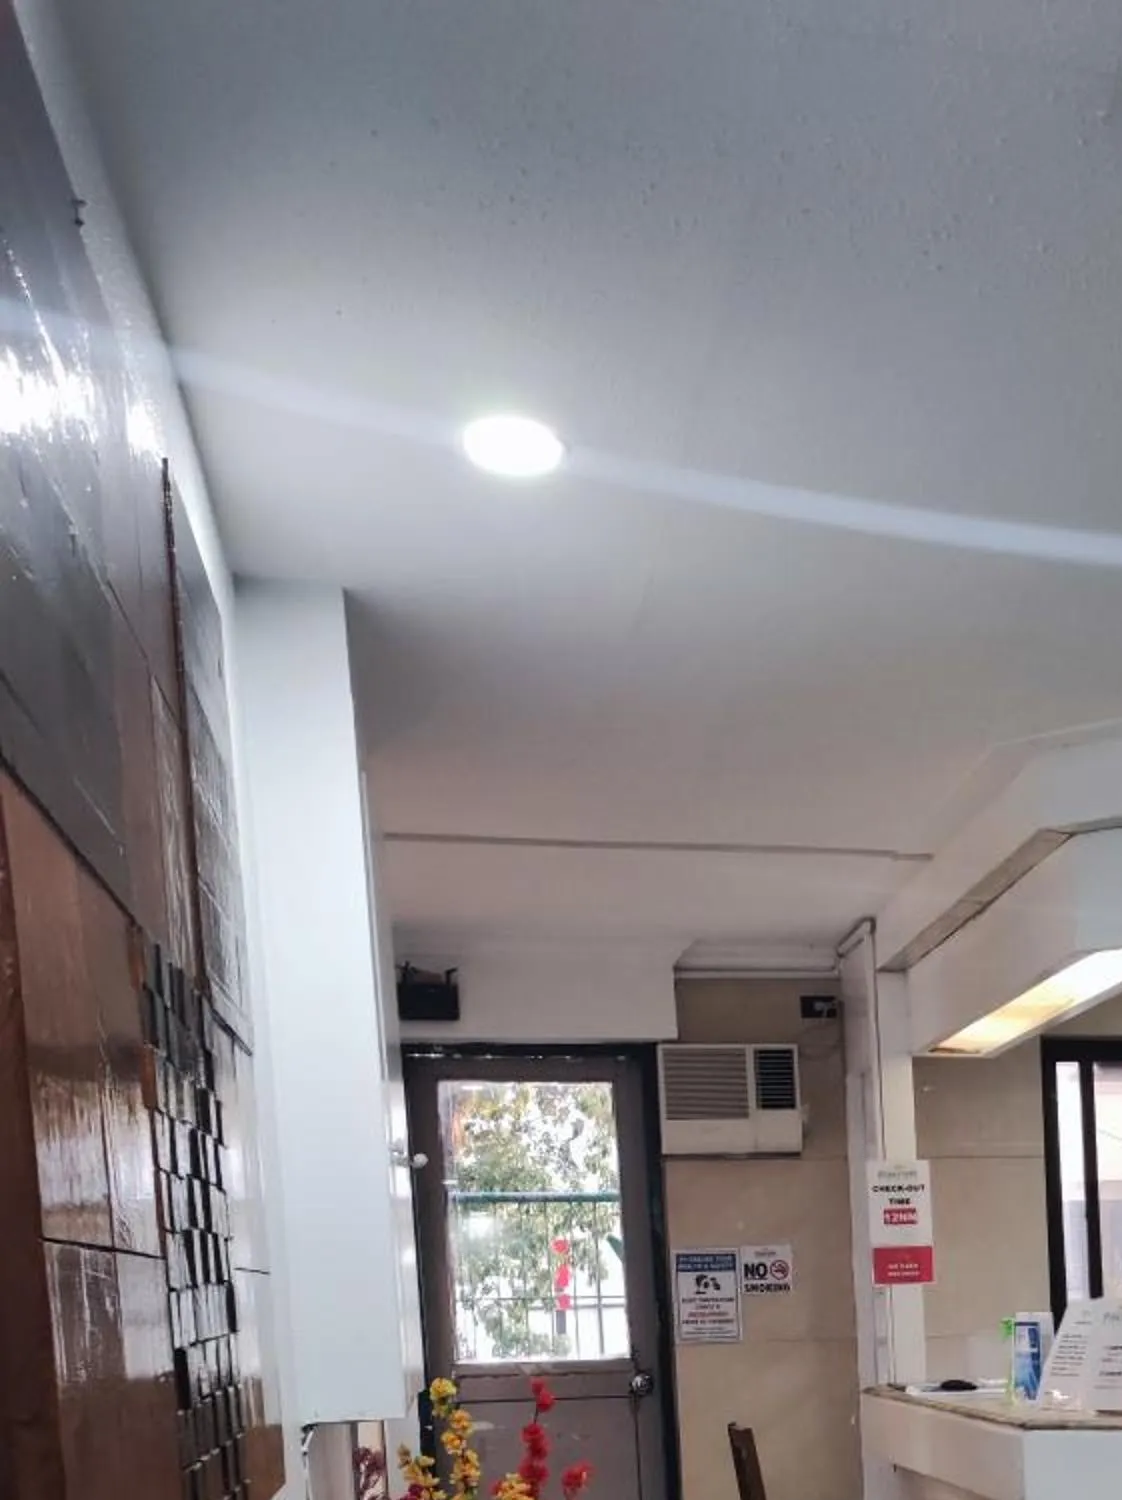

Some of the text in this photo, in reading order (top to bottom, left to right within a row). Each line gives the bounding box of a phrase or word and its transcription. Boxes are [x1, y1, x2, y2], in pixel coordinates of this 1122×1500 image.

[872, 1184, 925, 1193] CHECK-OUT
[888, 1197, 911, 1205] TIME
[744, 1262, 768, 1278] NO
[744, 1283, 790, 1293] SMOKING
